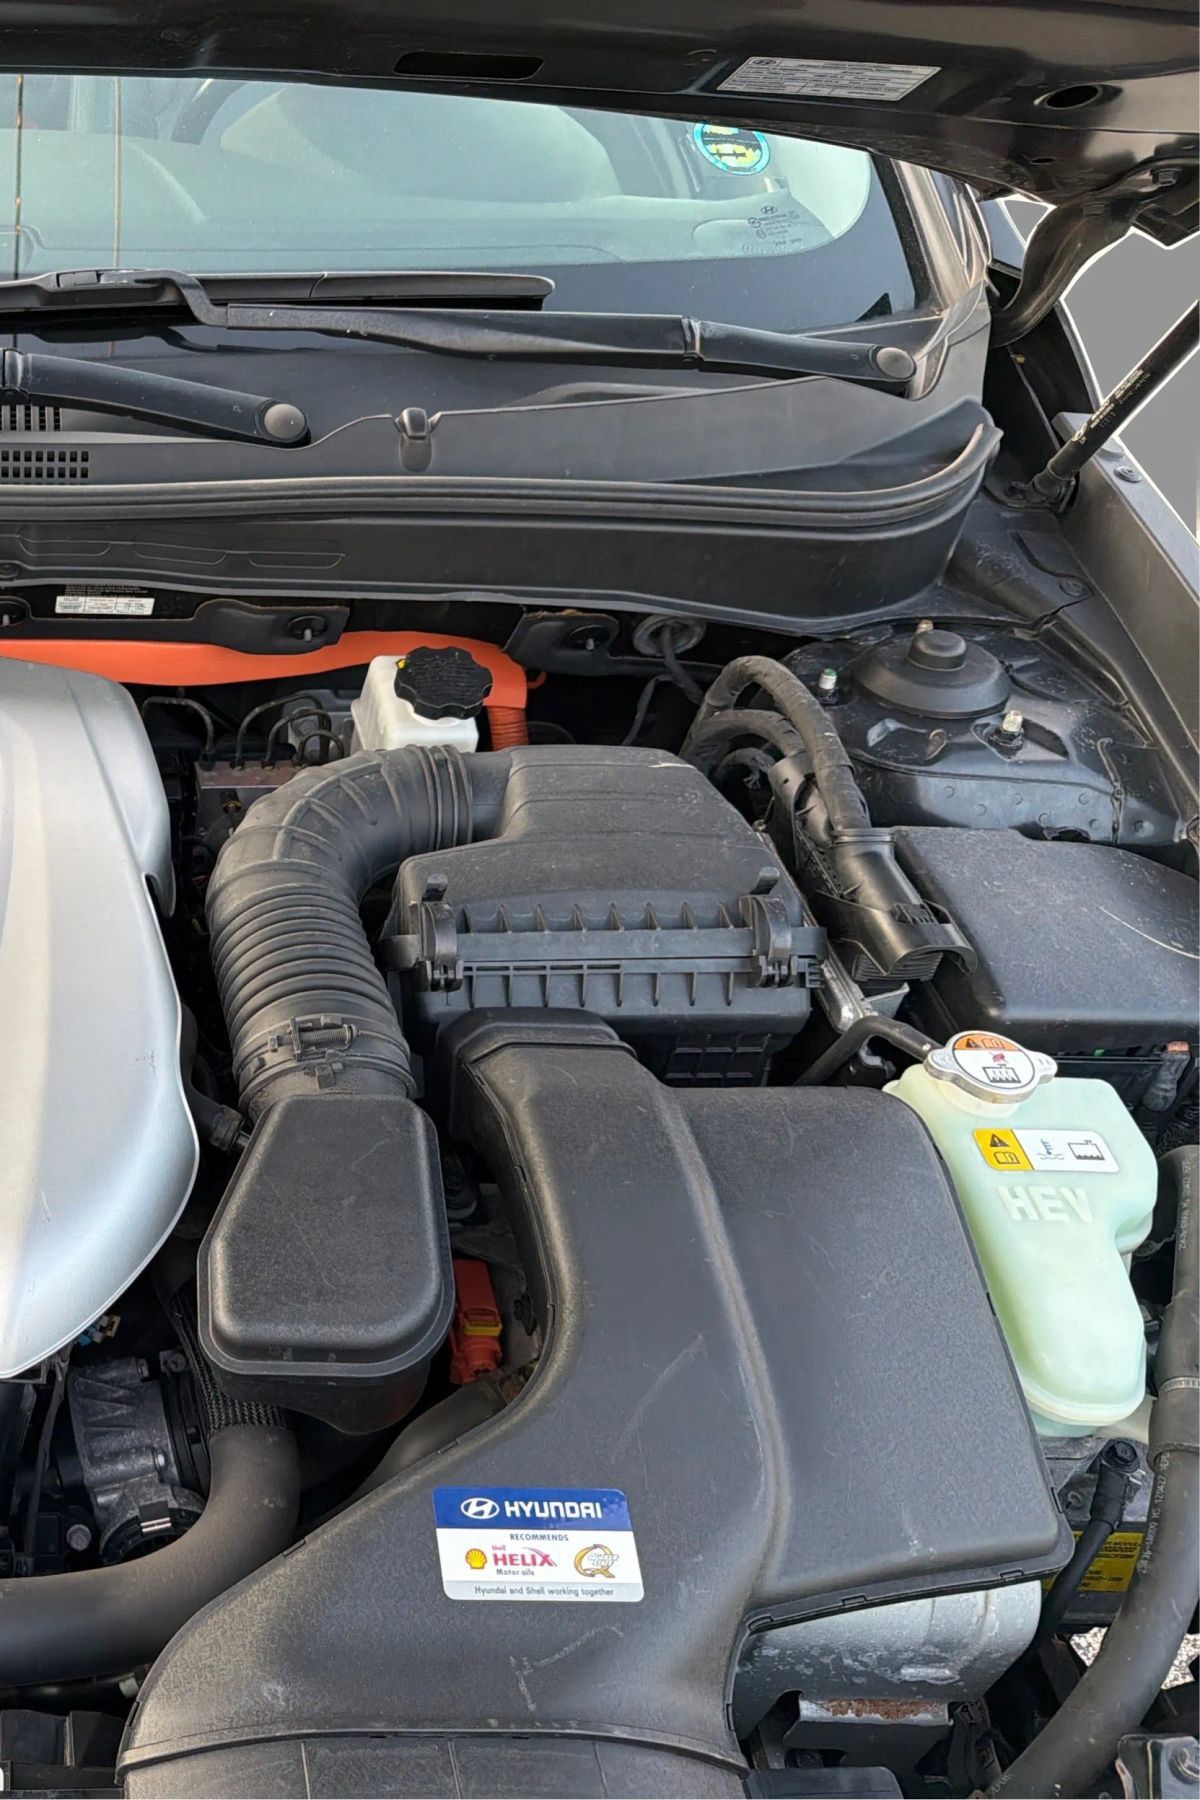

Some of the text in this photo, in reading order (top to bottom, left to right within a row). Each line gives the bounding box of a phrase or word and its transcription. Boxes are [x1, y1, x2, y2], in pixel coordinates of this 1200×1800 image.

[998, 1184, 1093, 1223] HEV
[506, 1501, 602, 1519] HYUNDAI
[493, 1552, 559, 1567] HELIX
[496, 1568, 519, 1576] Motor
[475, 1586, 507, 1595] Hyundai
[526, 1587, 545, 1595] Shell
[548, 1588, 579, 1596] working
[581, 1588, 613, 1597] together
